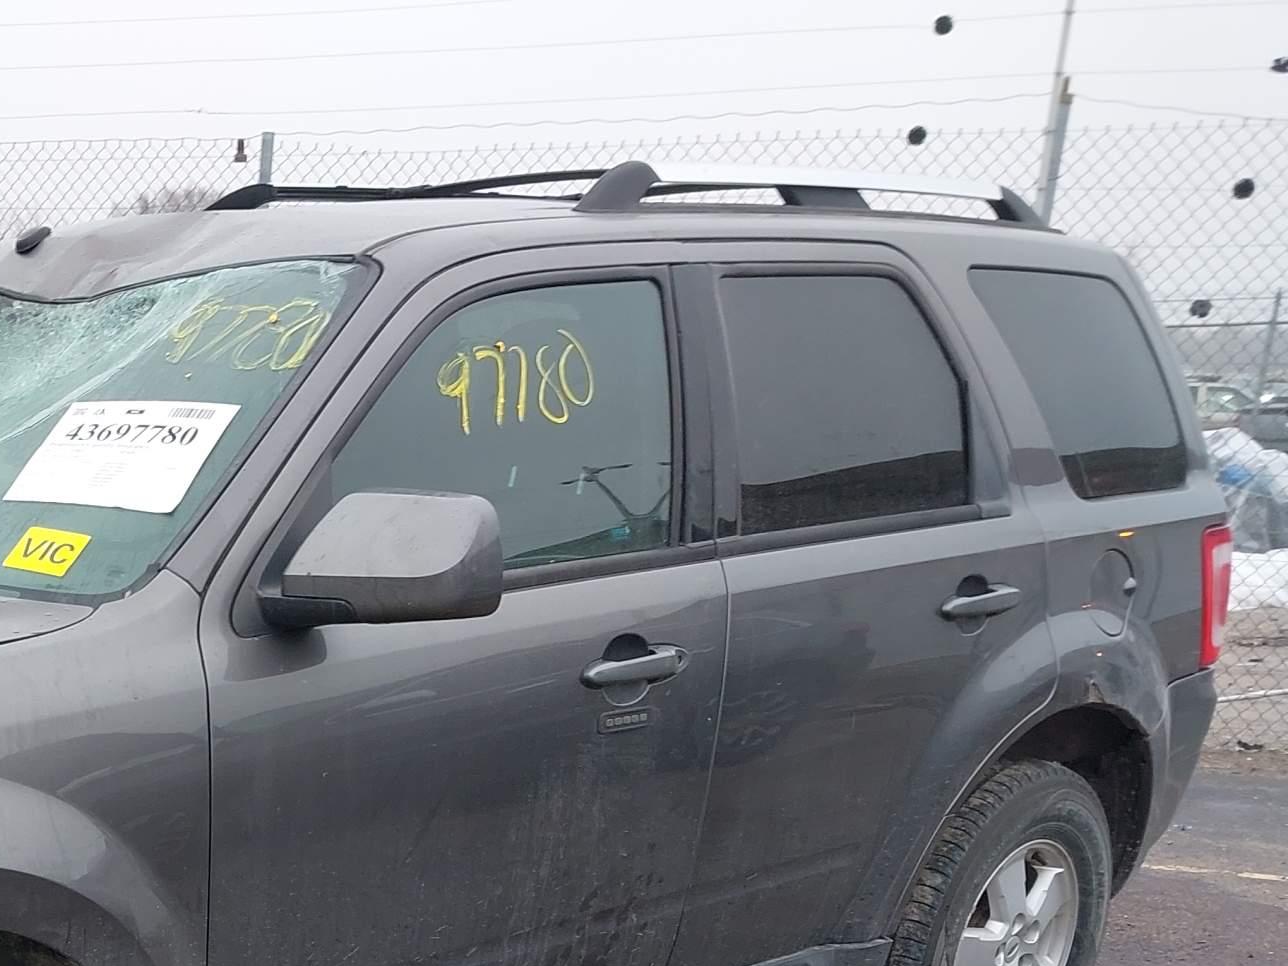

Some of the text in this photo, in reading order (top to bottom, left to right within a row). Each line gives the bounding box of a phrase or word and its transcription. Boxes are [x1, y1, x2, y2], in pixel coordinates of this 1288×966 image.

[437, 328, 594, 435] 97780
[65, 423, 199, 446] 43697780
[23, 537, 75, 564] VIC
